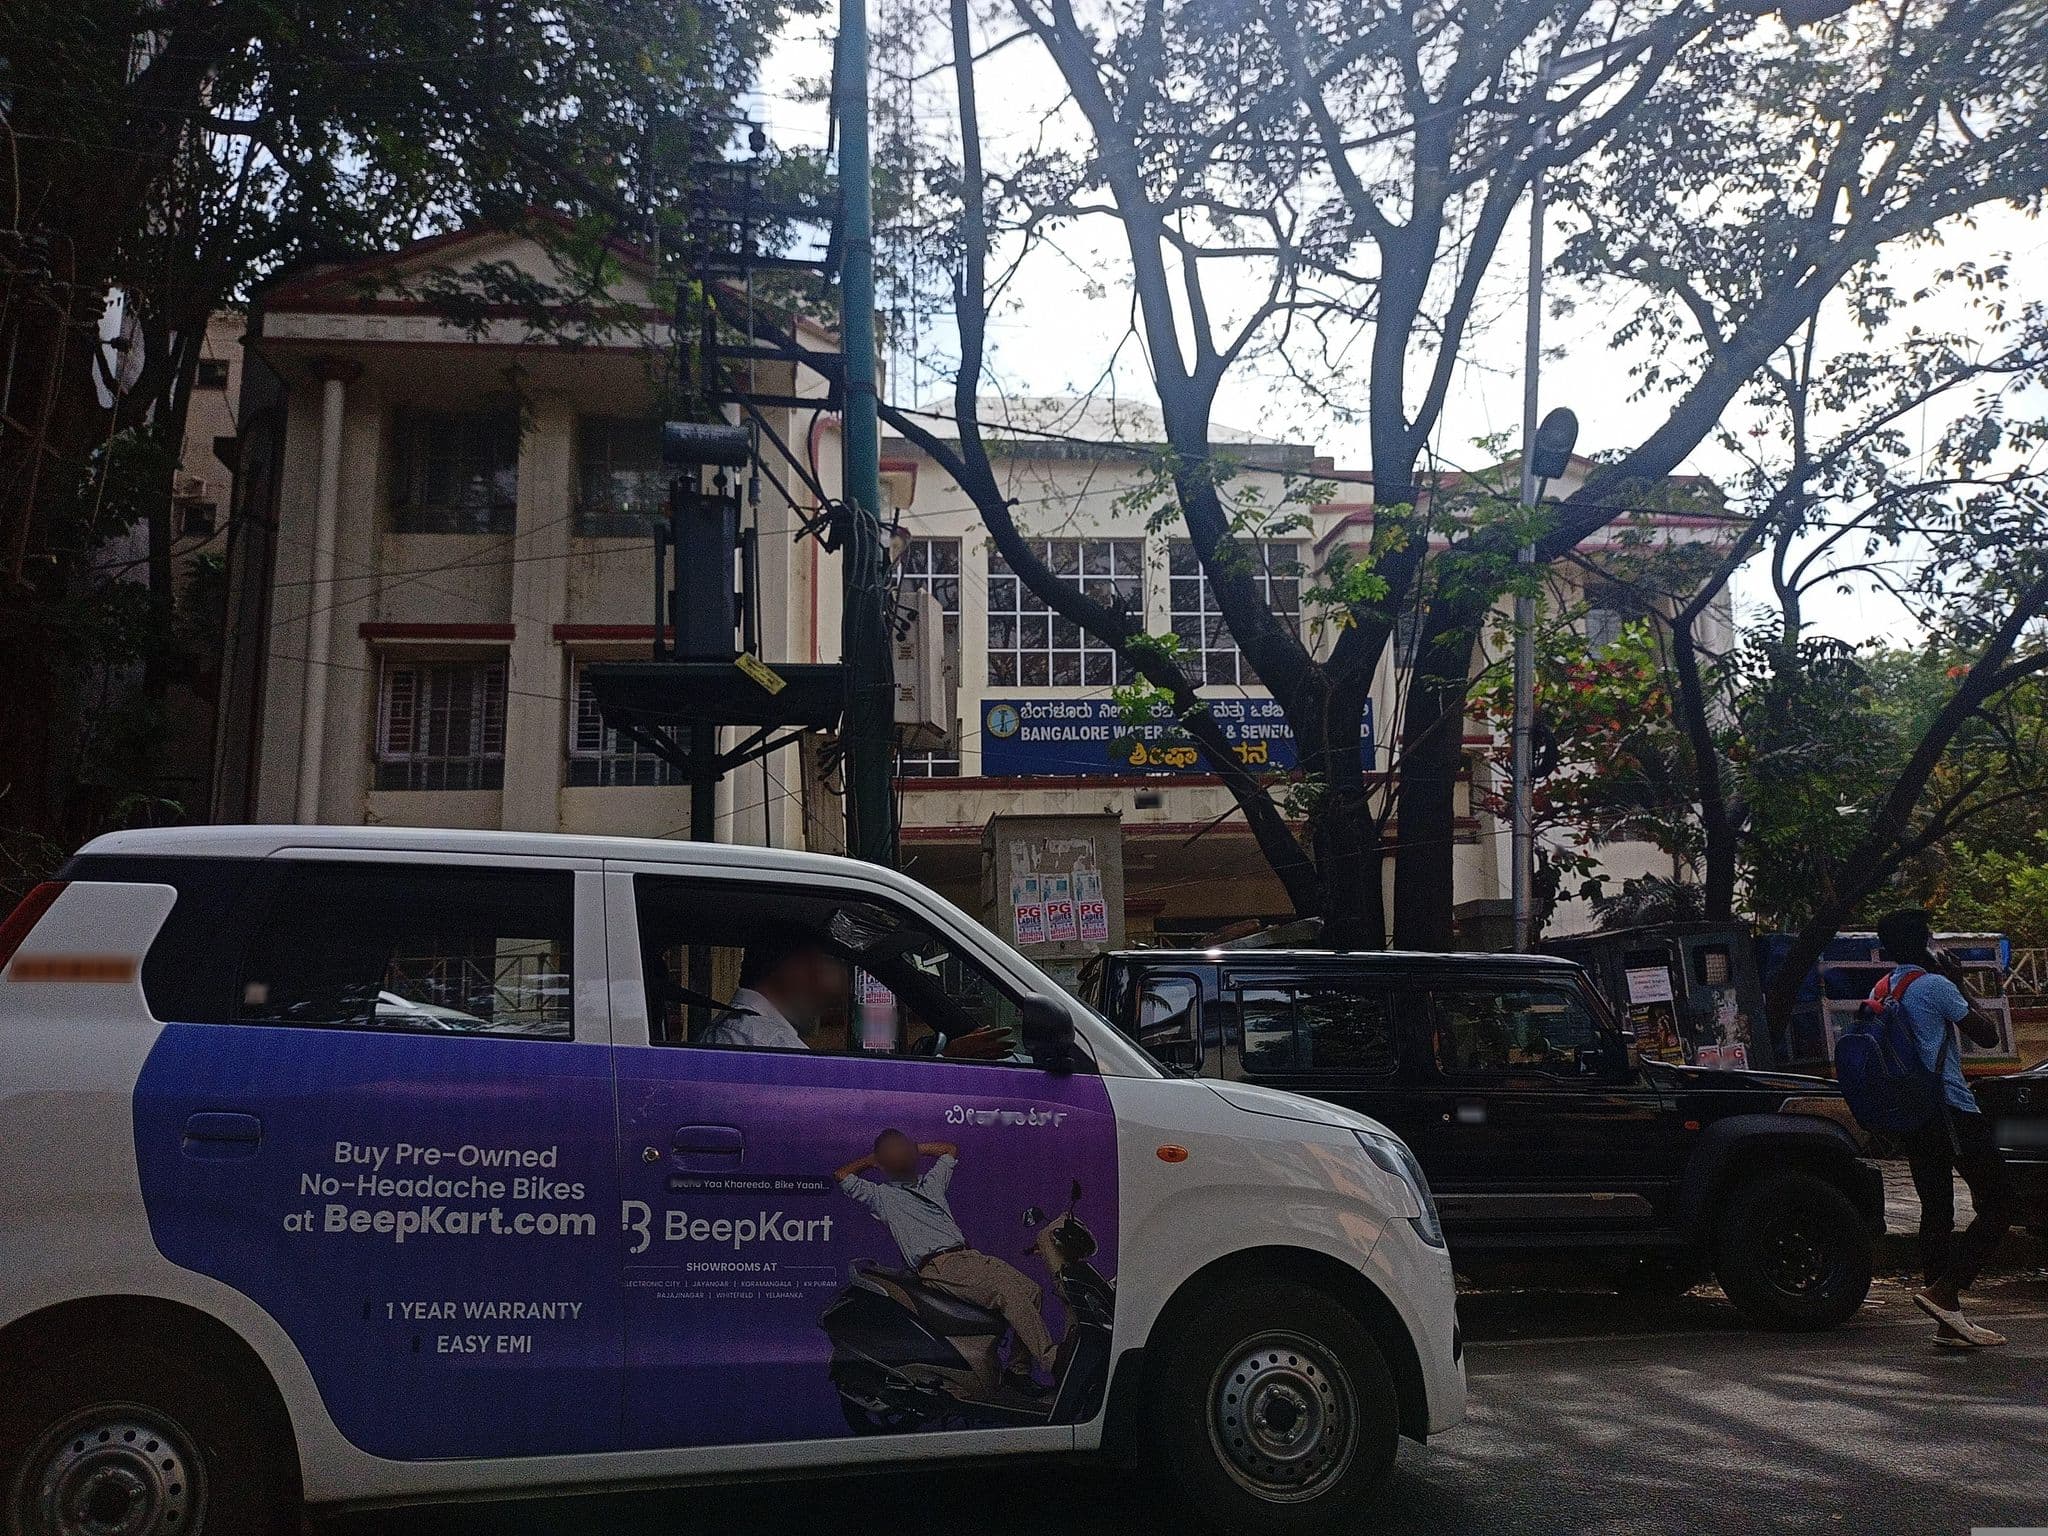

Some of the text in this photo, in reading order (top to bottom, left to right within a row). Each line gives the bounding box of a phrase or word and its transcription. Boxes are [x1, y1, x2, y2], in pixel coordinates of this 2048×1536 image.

[1020, 701, 1092, 719] ಬೆಂಗಳೂರು
[1213, 701, 1245, 722] ಮತ್ತು
[1021, 726, 1109, 741] BANGALORE
[1225, 724, 1237, 739] &
[1017, 907, 1041, 919] PG
[1047, 903, 1071, 915] PG
[1080, 903, 1104, 915] PG
[1018, 915, 1041, 925] LADIES
[334, 1141, 558, 1171] Buy Pre-Owned
[300, 1173, 586, 1200] No-Headache Bikes
[704, 1179, 723, 1189] Yaa
[775, 1180, 794, 1189] Bike
[283, 1203, 597, 1243] at BeepKart.com
[665, 1210, 833, 1250] BeepKart
[686, 1262, 777, 1272] SHOWROOMS AT
[385, 1302, 583, 1320] 1 YEAR WARRANTY
[436, 1335, 532, 1353] EASY EMI
